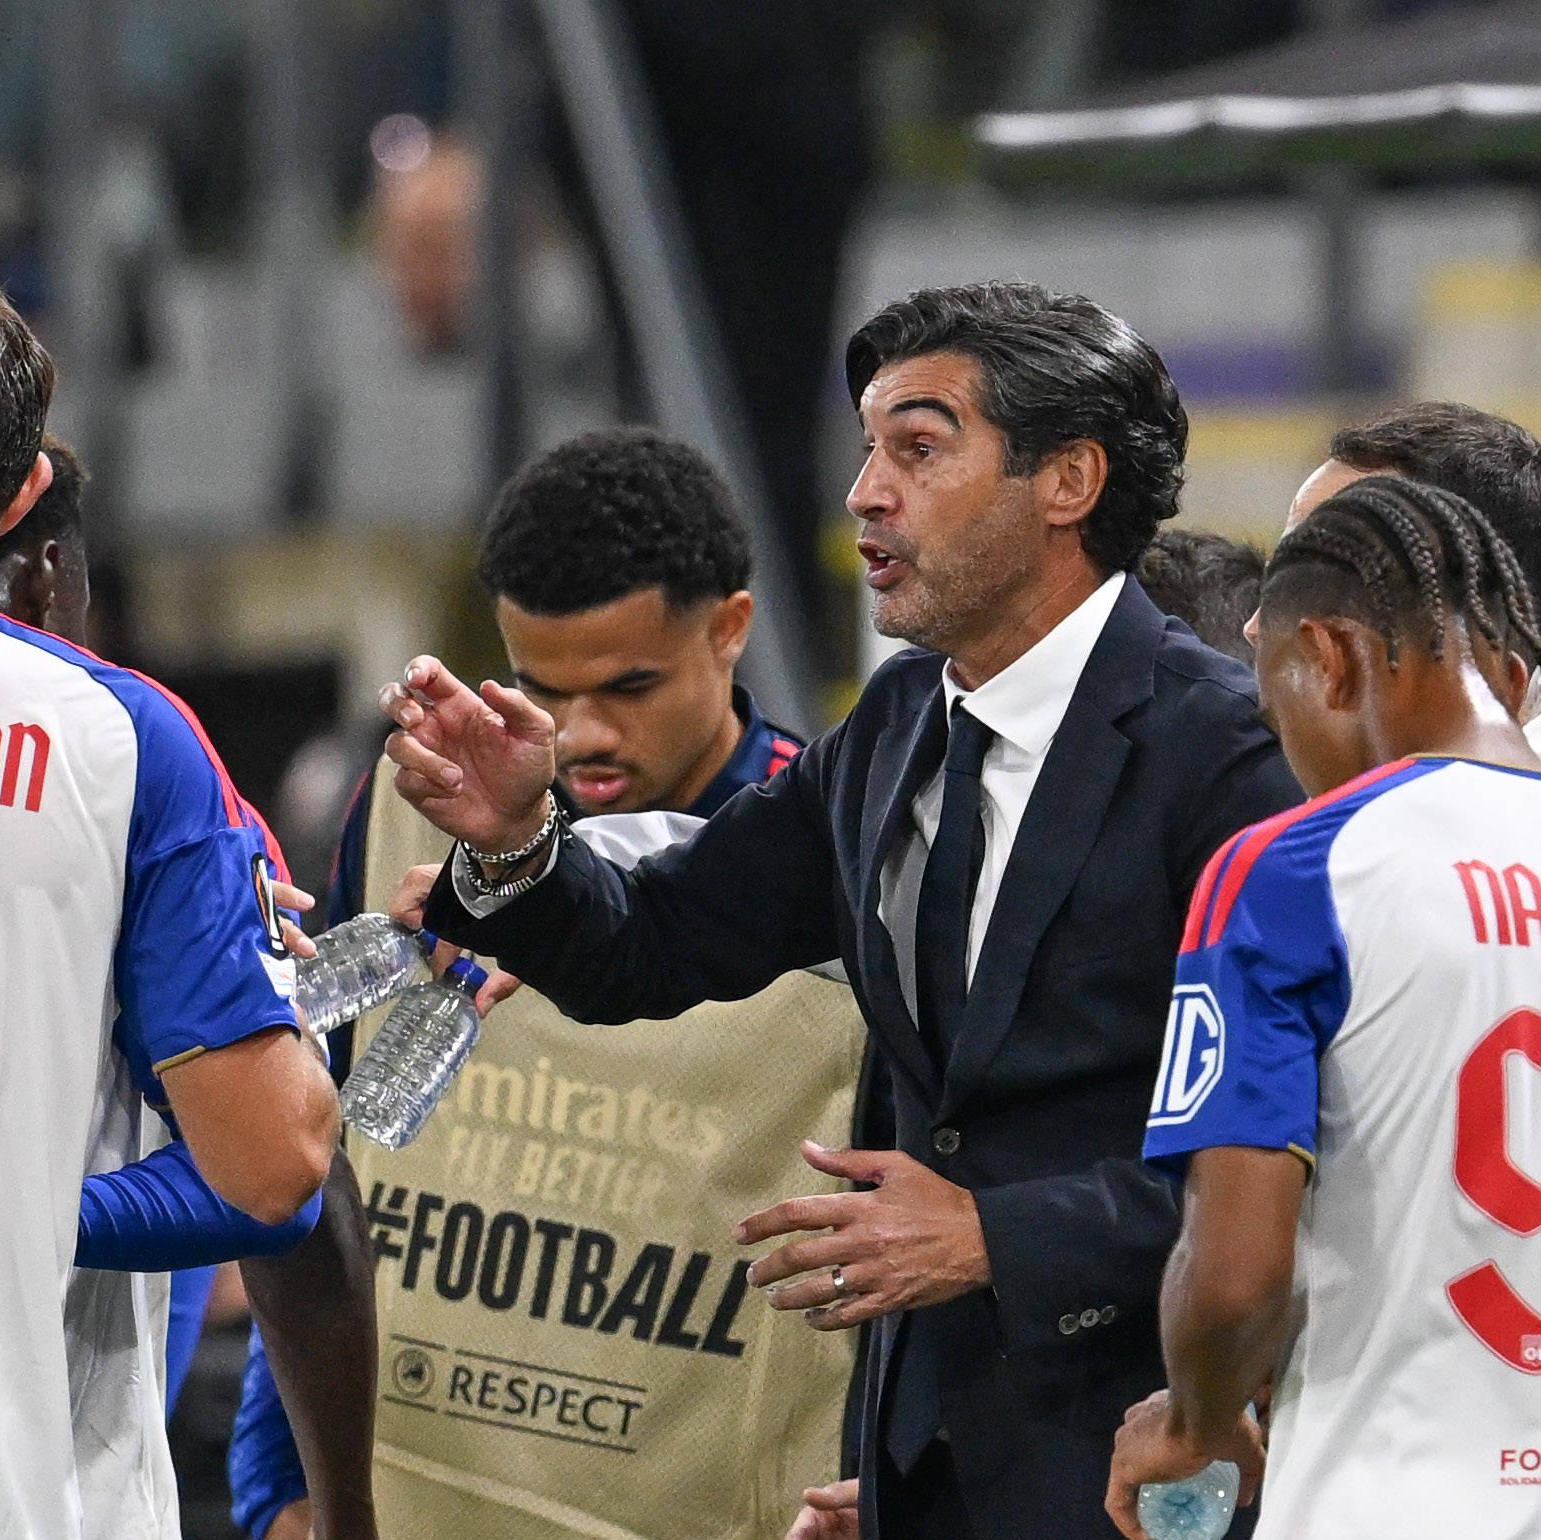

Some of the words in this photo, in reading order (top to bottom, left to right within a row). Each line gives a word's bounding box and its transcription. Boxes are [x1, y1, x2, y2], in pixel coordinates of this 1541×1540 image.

[439, 1056, 725, 1159] mirates
[366, 1182, 755, 1358] #FOOTBALL
[449, 1364, 642, 1436] RESPECT
